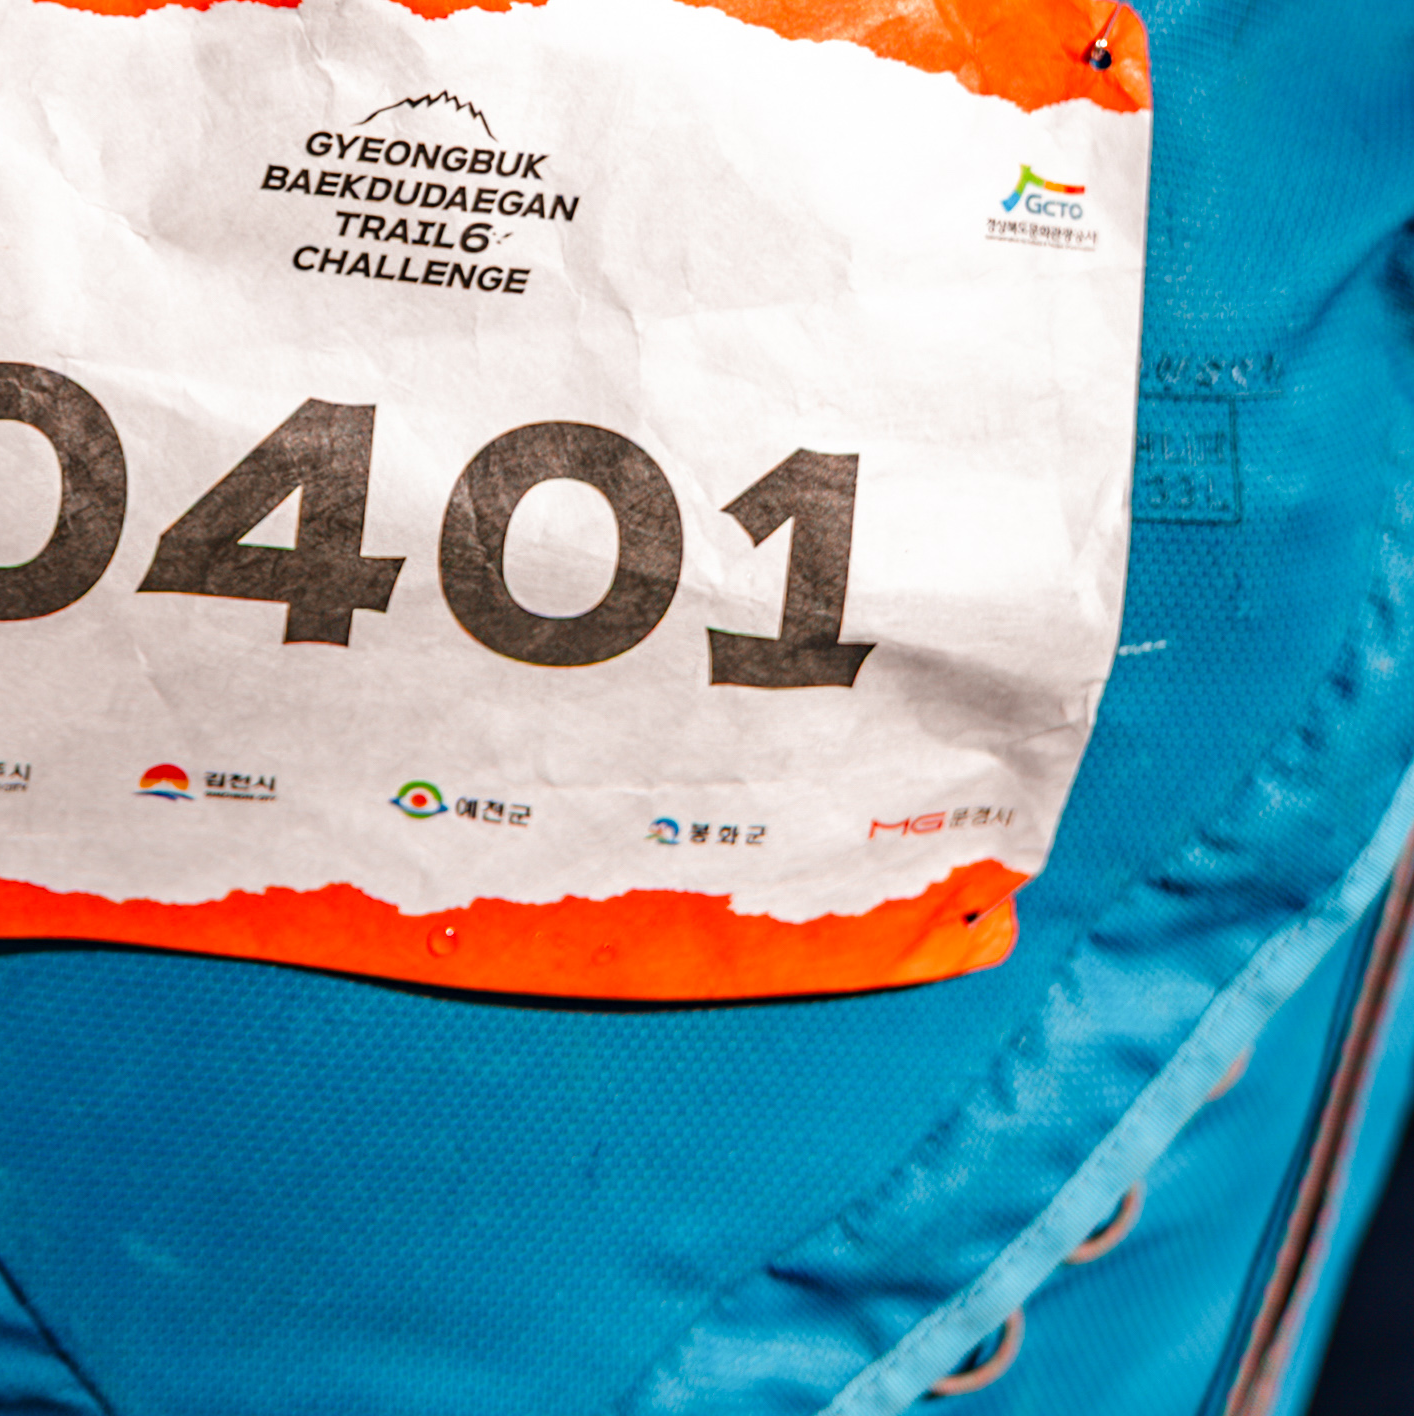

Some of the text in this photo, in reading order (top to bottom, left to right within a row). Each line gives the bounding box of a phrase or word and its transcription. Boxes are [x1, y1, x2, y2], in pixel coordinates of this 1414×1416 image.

[305, 130, 550, 182] GYEONGBUK
[260, 164, 581, 222] BAEKDUDAEGAN
[292, 245, 532, 294] CHALLENGE
[455, 796, 531, 828] 예천군
[690, 822, 767, 846] 봉화군
